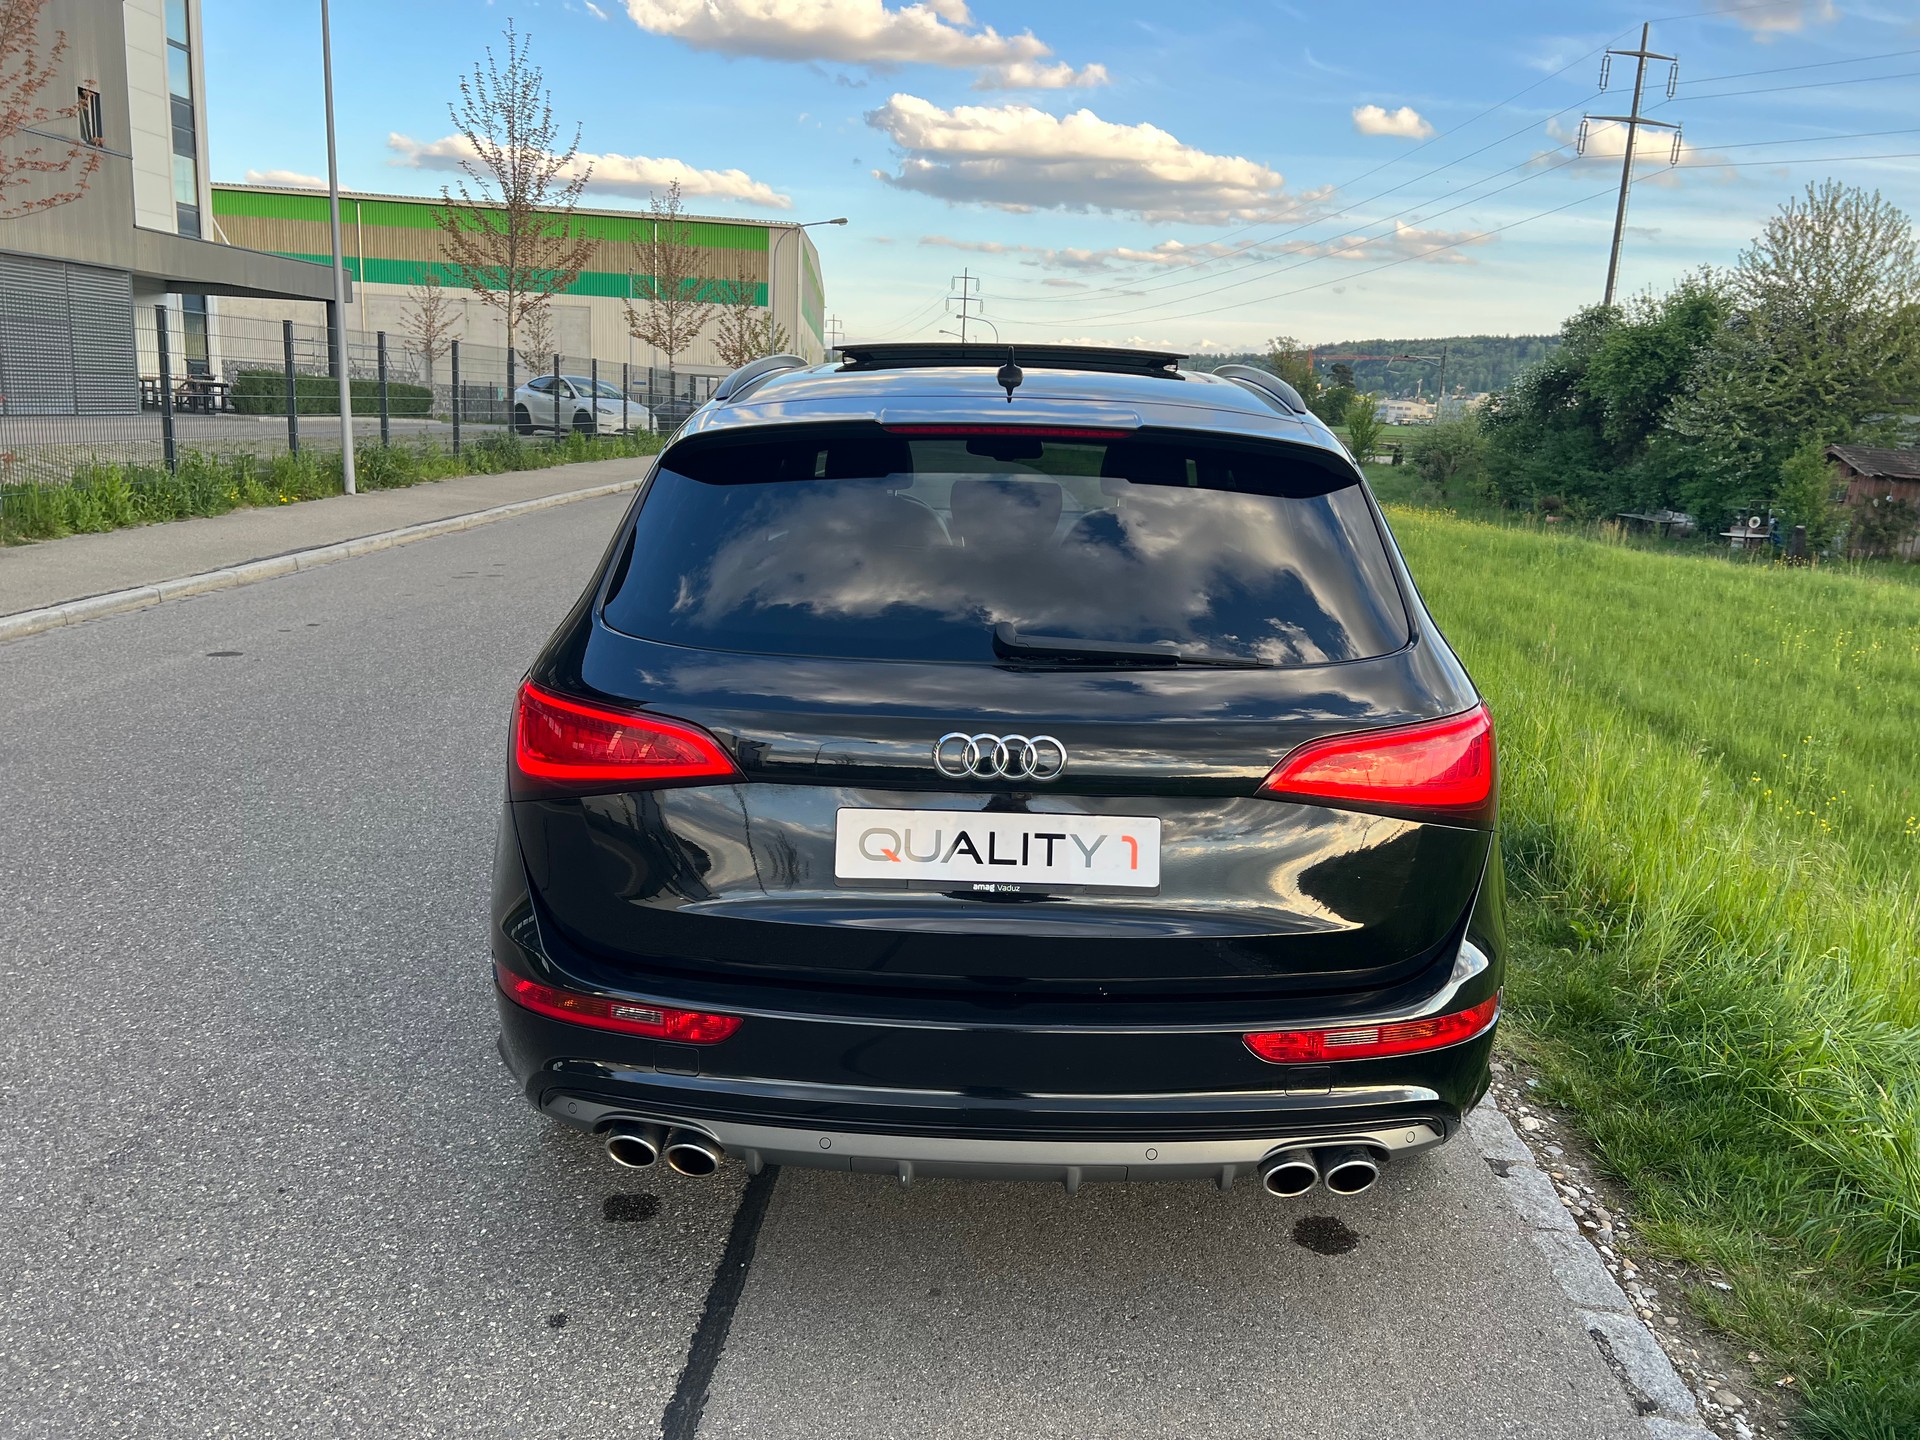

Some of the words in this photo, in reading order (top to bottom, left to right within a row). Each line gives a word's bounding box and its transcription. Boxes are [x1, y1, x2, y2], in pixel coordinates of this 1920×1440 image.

[858, 828, 1108, 868] QUALITY
[1121, 835, 1139, 870] 1
[972, 883, 996, 893] amag
[997, 884, 1021, 893] Vaduz
